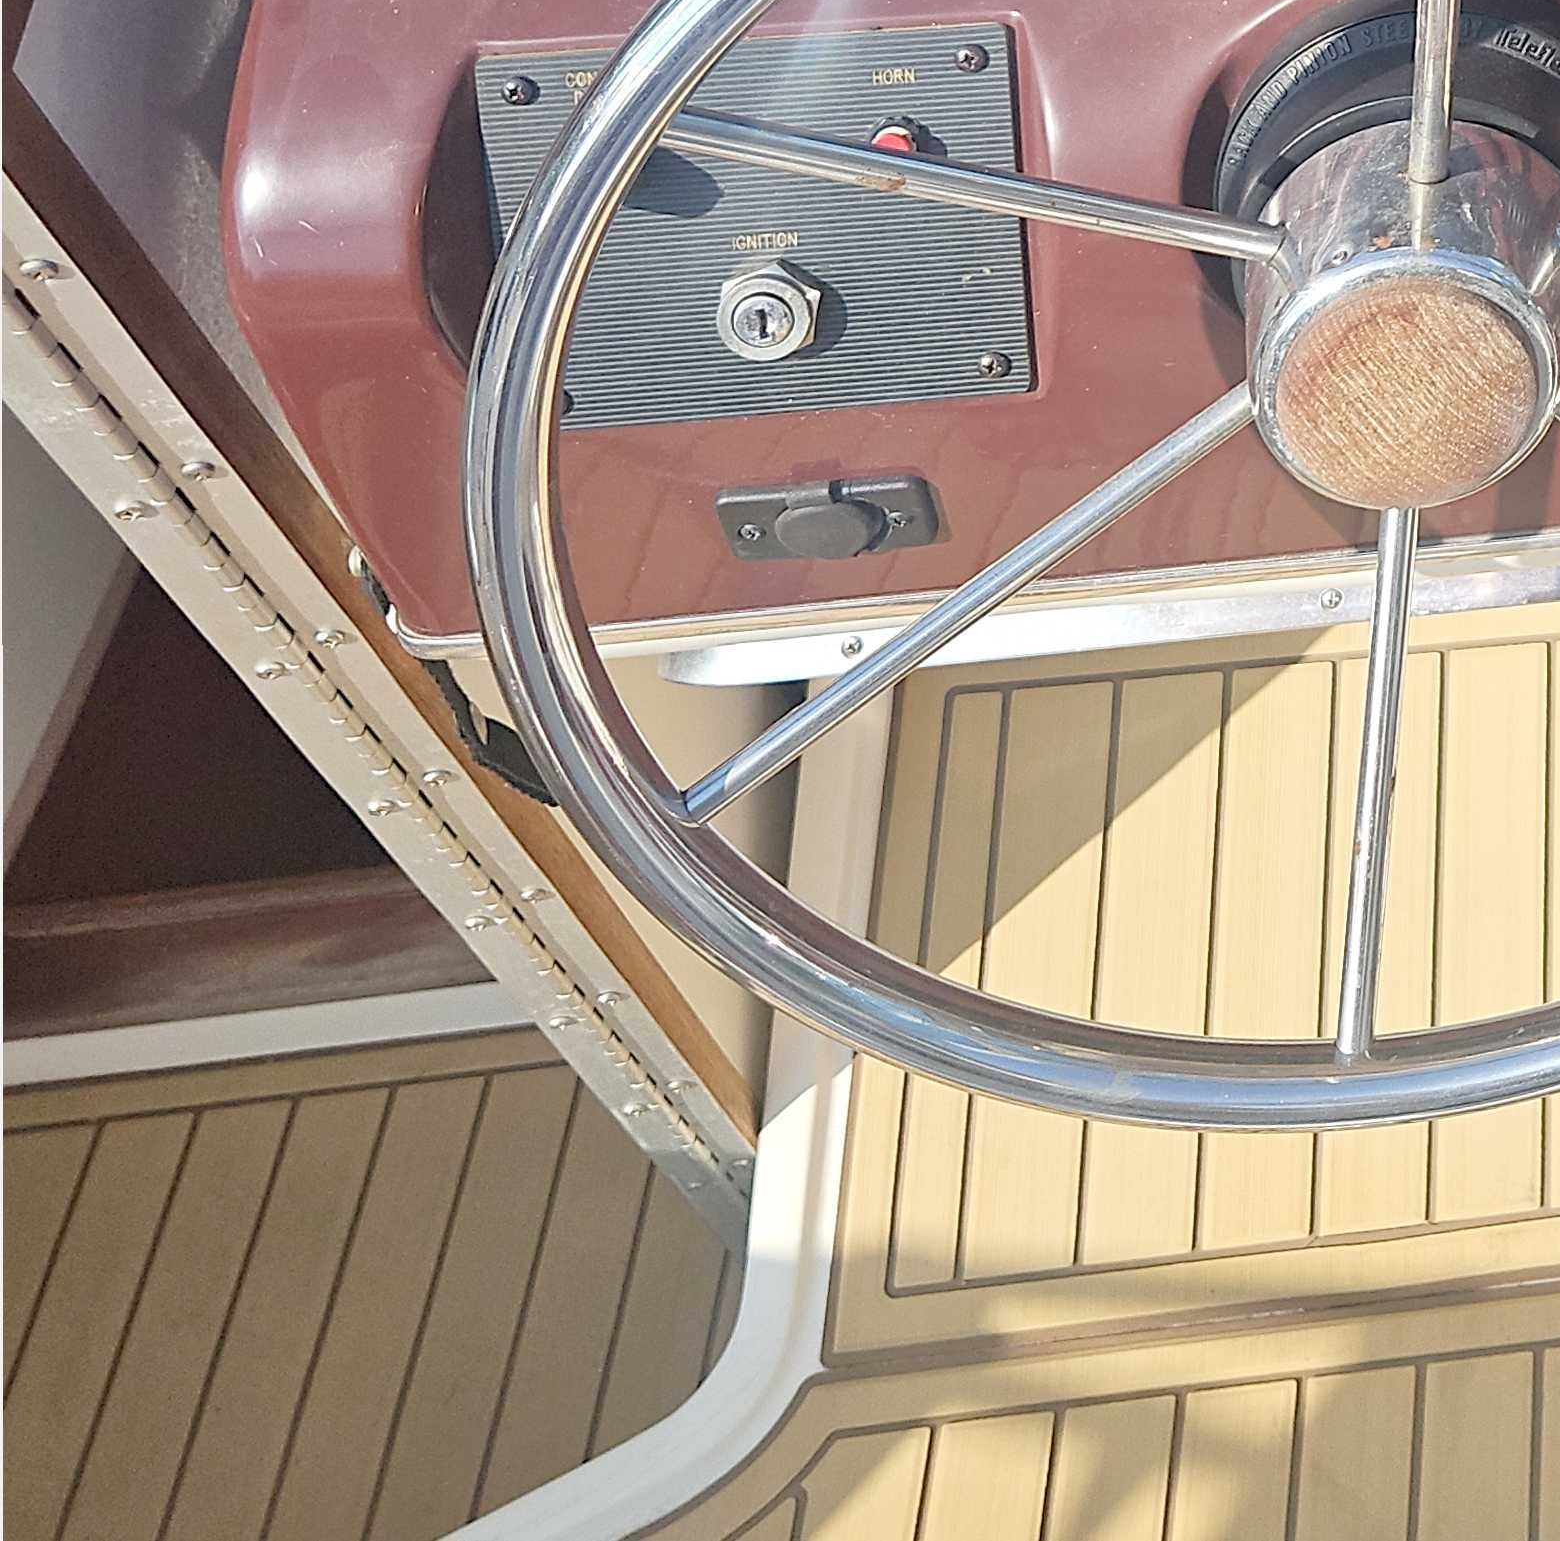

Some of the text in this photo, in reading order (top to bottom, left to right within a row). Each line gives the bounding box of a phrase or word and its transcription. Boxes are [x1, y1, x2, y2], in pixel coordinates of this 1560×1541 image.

[1285, 33, 1353, 86] PINION
[872, 67, 917, 86] HORN
[731, 231, 799, 252] IGNITION
